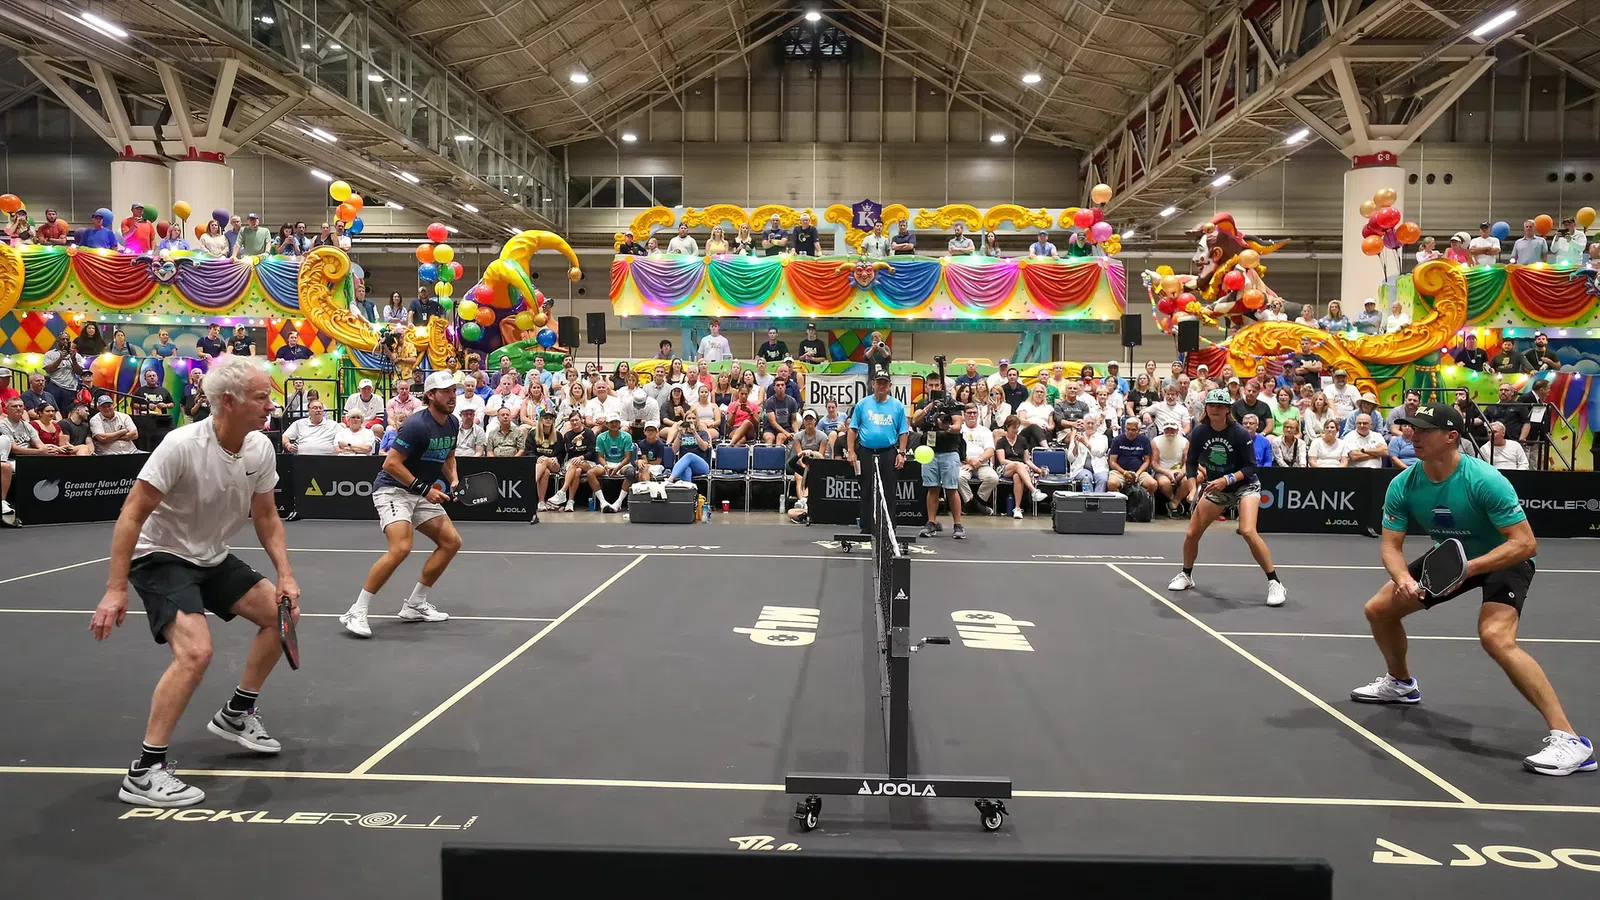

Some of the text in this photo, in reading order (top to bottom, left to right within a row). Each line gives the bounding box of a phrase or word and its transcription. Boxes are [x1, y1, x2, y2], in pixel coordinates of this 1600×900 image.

[857, 211, 875, 226] K
[64, 478, 136, 490] Greater New Orle
[324, 480, 373, 497] JOO
[64, 486, 131, 499] Sports Foundati
[1519, 499, 1600, 511] PICKLERO
[872, 782, 937, 797] JOOLA
